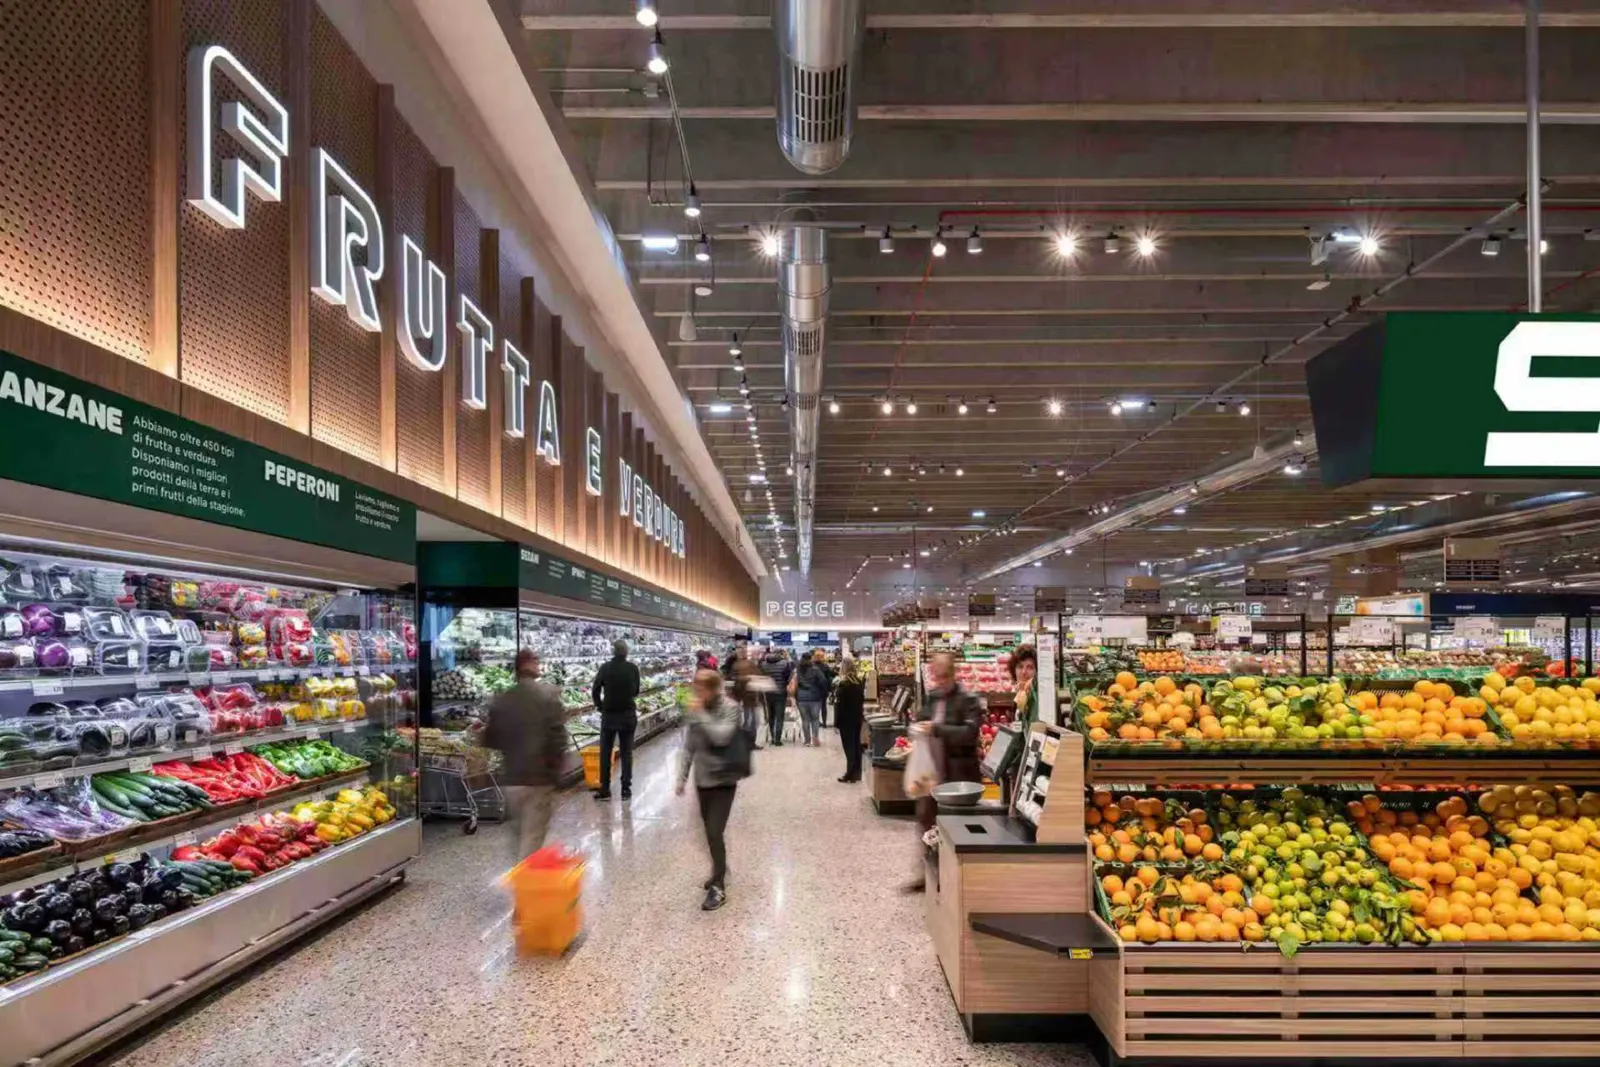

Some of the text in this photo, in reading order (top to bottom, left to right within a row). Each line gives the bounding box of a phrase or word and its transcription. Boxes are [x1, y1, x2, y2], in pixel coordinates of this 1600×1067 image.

[187, 45, 685, 558] FRUTTA E VERDURA
[0, 370, 123, 435] ANZANE
[132, 415, 235, 458] Abbiamo oltre 450 tipi
[132, 432, 218, 467] di frutta e verdura.
[132, 446, 190, 474] Disponiamo
[196, 468, 228, 484] migliori
[132, 466, 173, 484] prodotti
[175, 476, 197, 490] della
[199, 482, 220, 496] terra
[220, 490, 226, 498] e
[264, 459, 340, 502] PEPERONI
[132, 482, 158, 496] primi
[160, 486, 184, 502] frutti
[186, 494, 208, 508] della
[1126, 577, 1132, 587] 3
[1248, 566, 1255, 576] 2
[766, 601, 845, 617] PESCE
